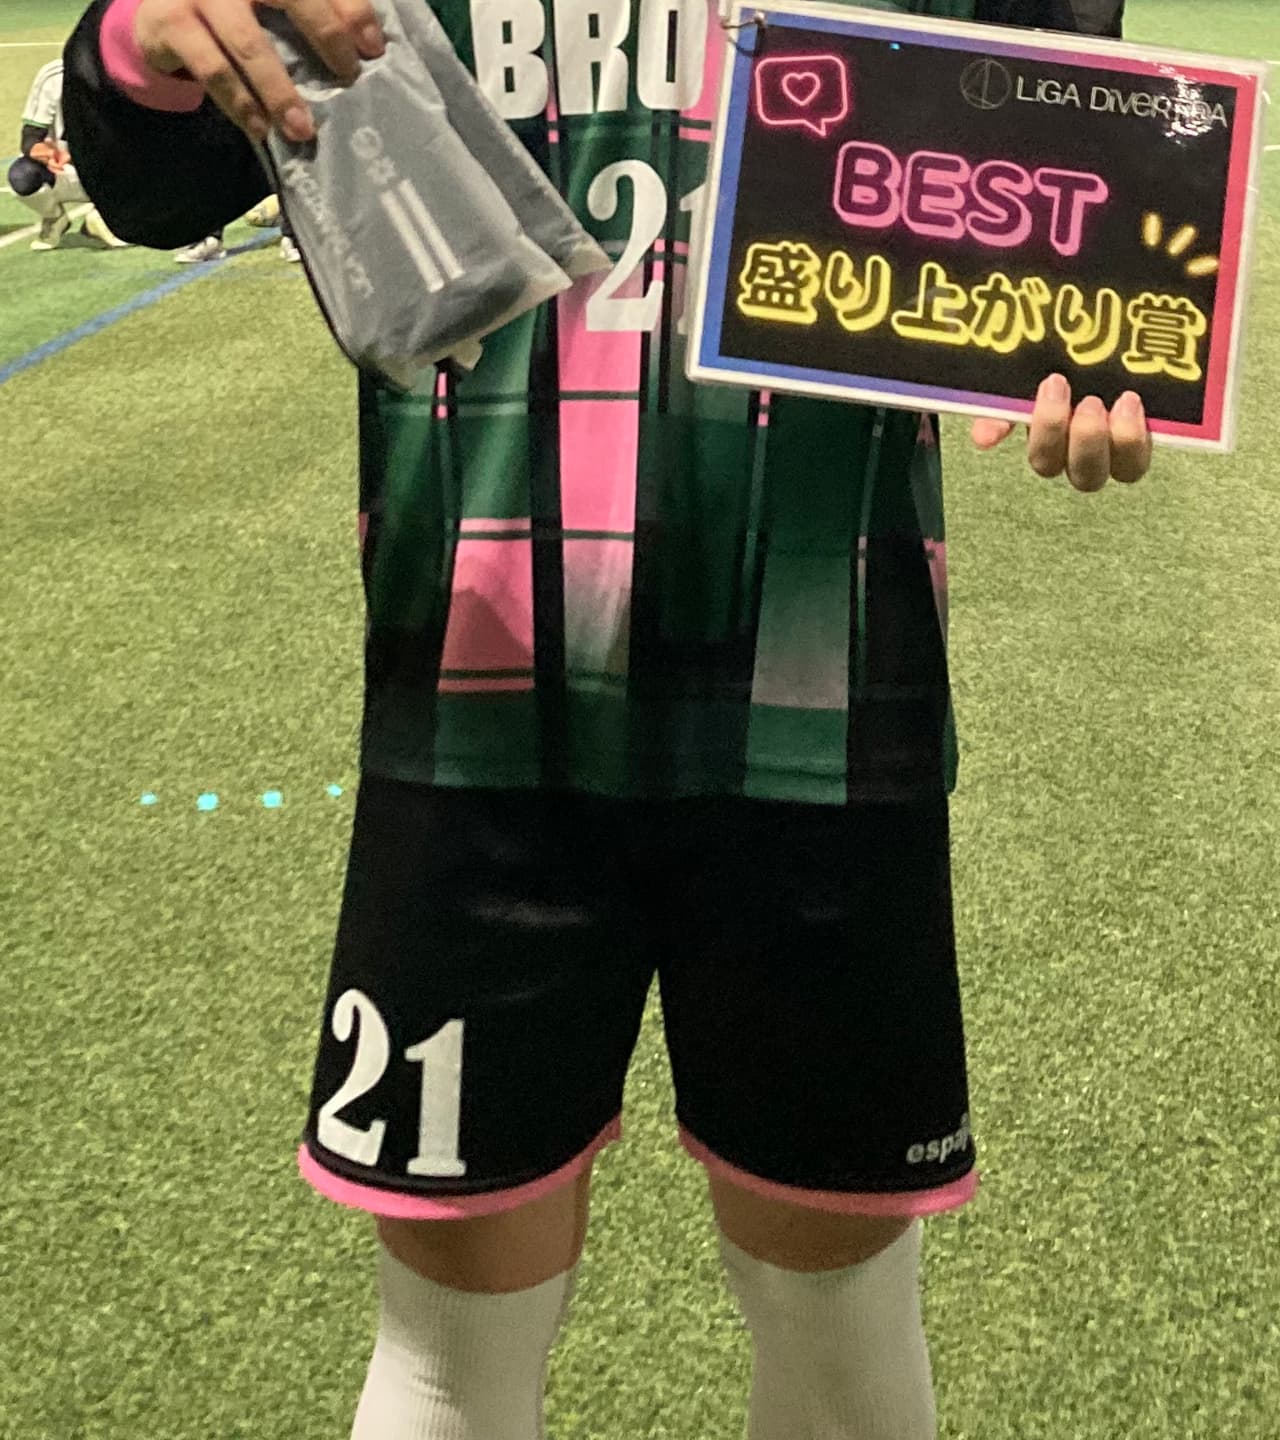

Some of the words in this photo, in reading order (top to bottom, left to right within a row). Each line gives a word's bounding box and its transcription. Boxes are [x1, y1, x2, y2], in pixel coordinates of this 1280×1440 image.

[833, 140, 1110, 256] BEST
[737, 240, 1208, 381] 盛り上がり賞
[317, 988, 467, 1178] 21
